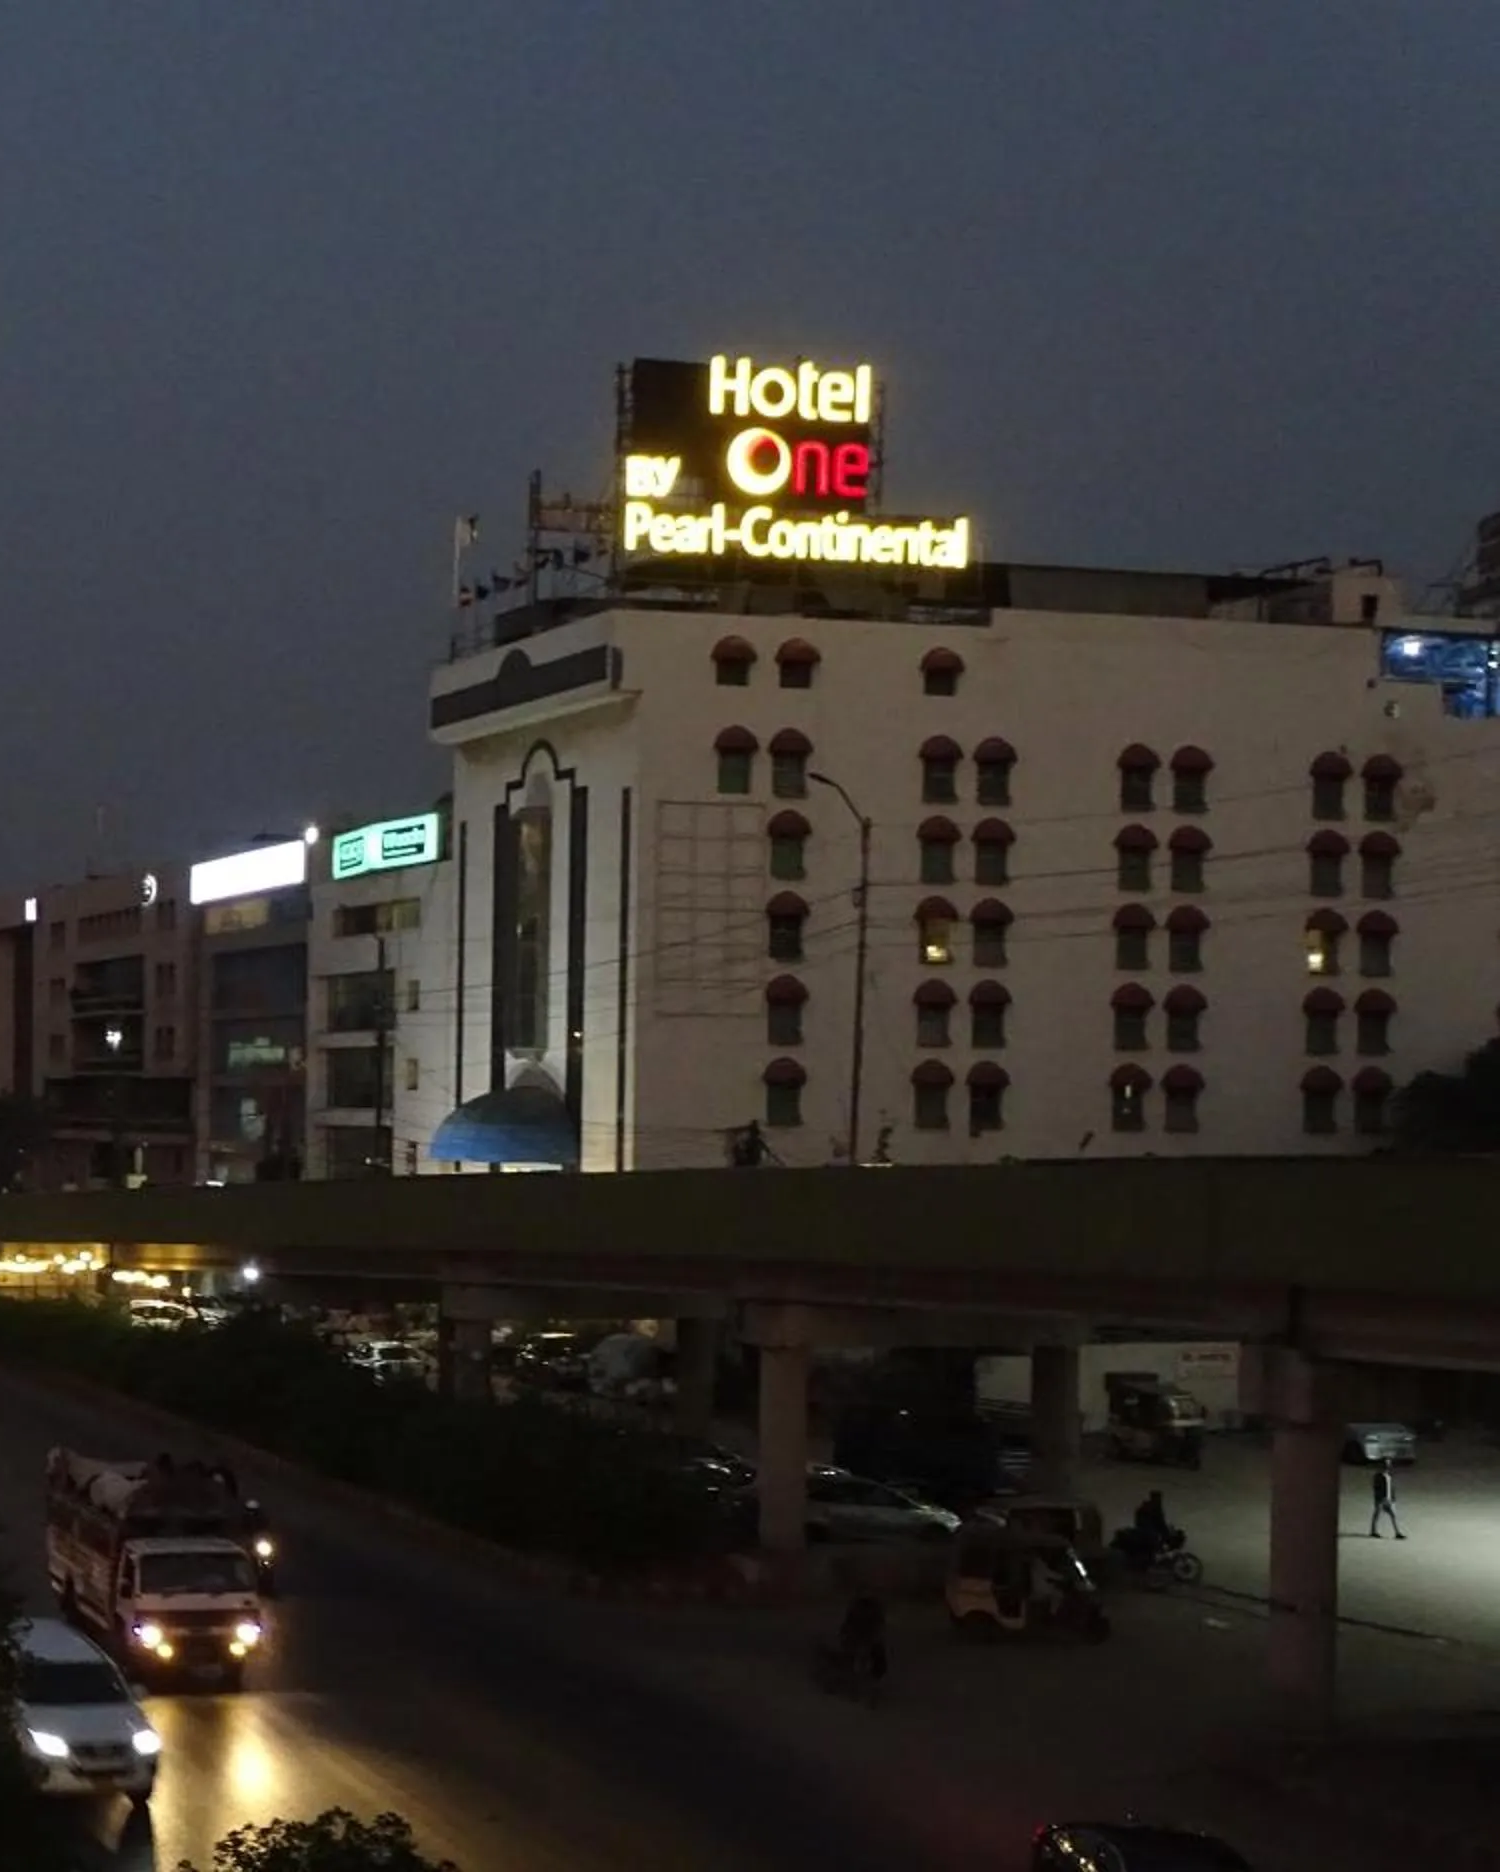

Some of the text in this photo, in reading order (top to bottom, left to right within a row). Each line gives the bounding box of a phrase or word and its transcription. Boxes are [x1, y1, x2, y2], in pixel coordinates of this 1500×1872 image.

[708, 354, 872, 424] Hotel
[726, 427, 870, 498] One
[624, 502, 969, 569] Pearl-Continental
